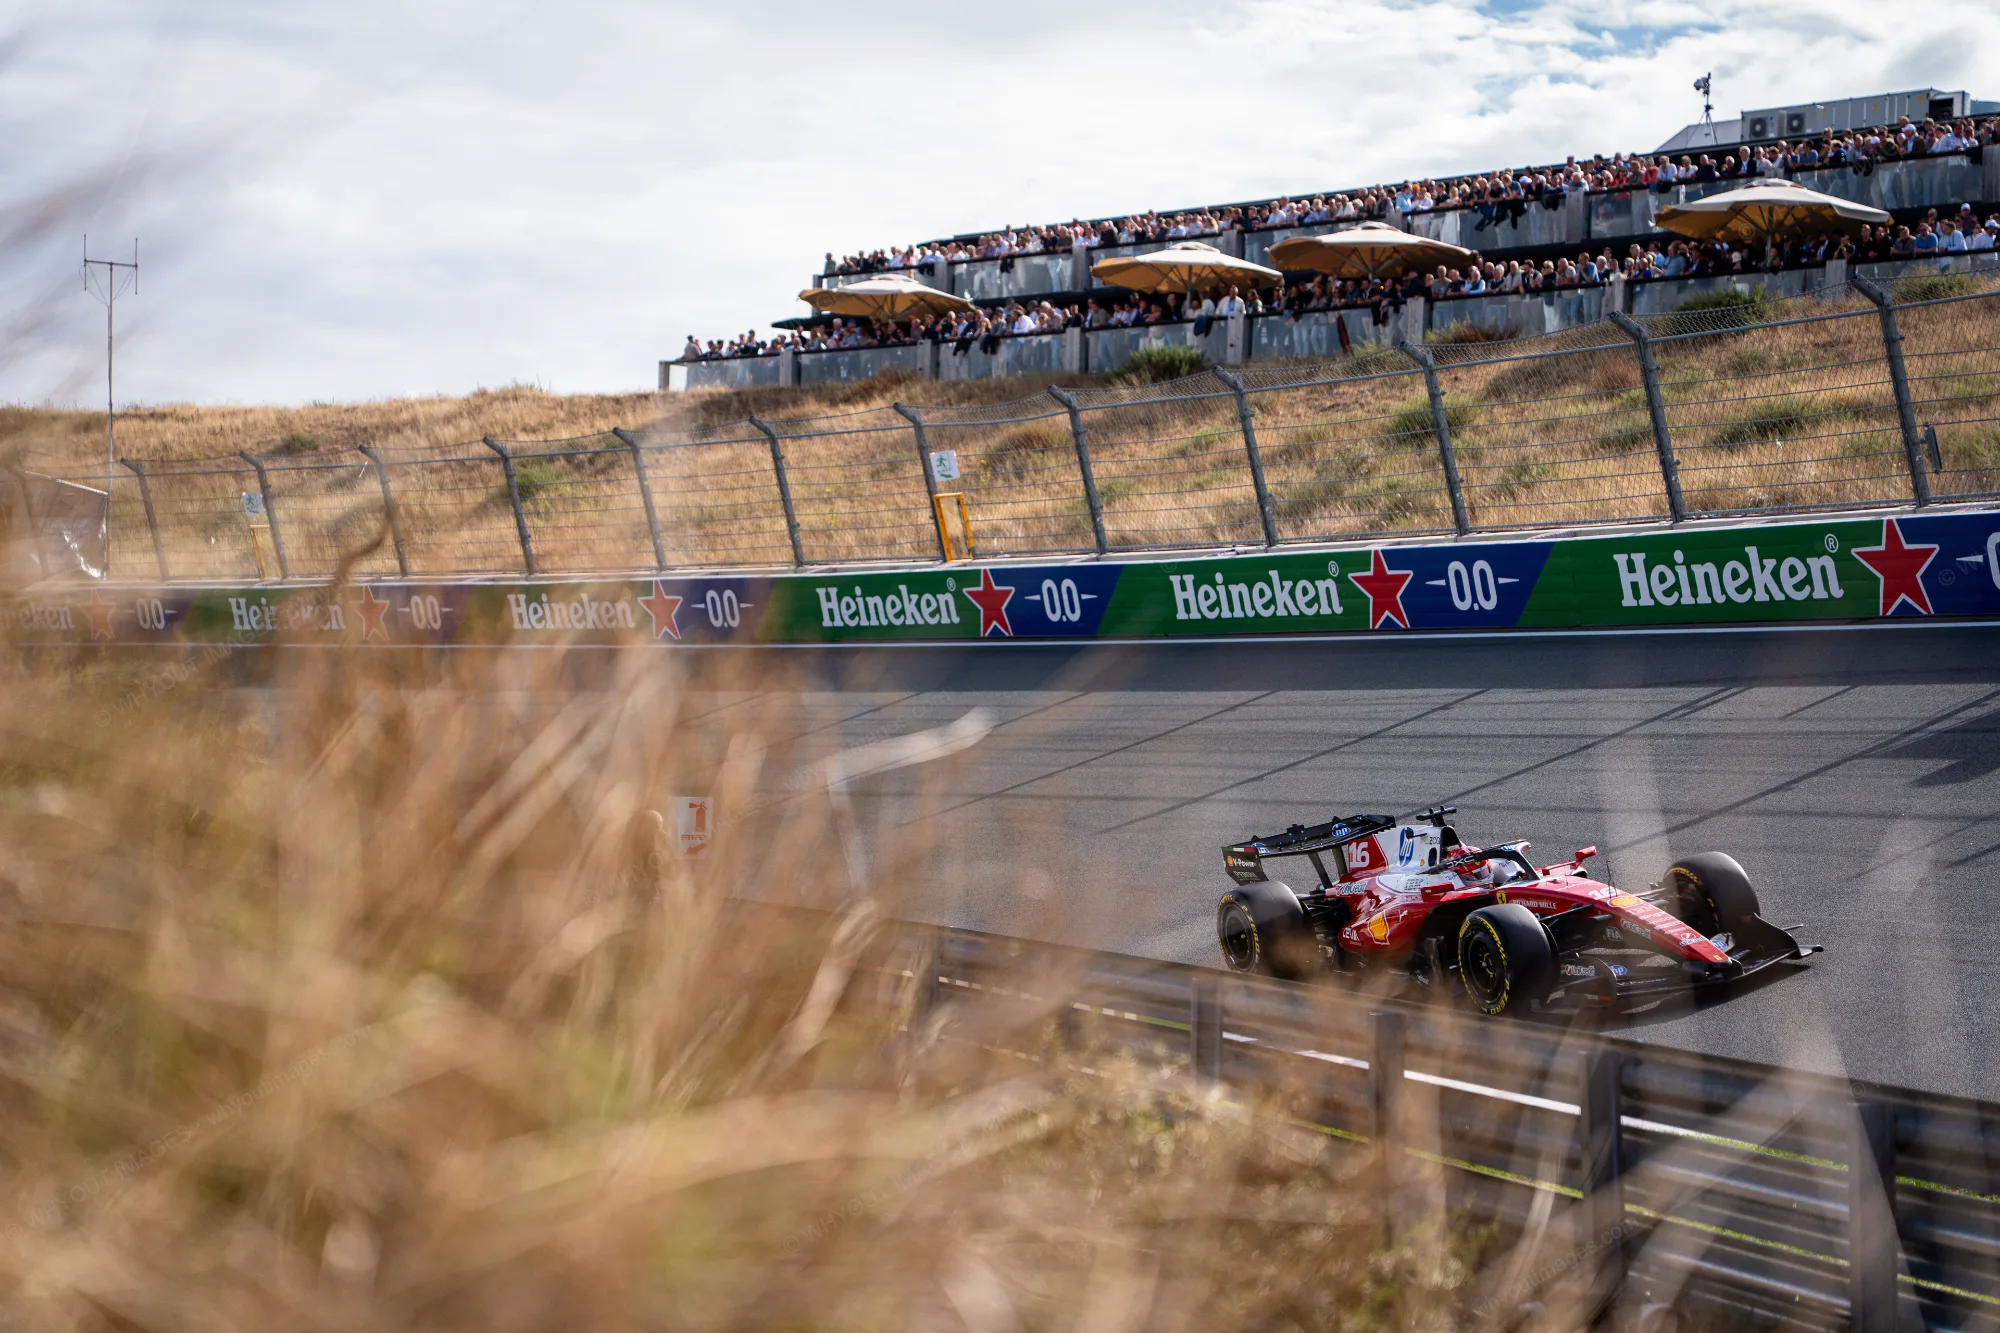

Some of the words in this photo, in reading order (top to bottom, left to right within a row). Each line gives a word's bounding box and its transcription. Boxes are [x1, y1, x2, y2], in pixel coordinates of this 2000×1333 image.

[1348, 841, 1371, 868] 16
[1400, 827, 1414, 867] hp
[1446, 855, 1475, 869] DXC
[1540, 901, 1558, 910] MILLE
